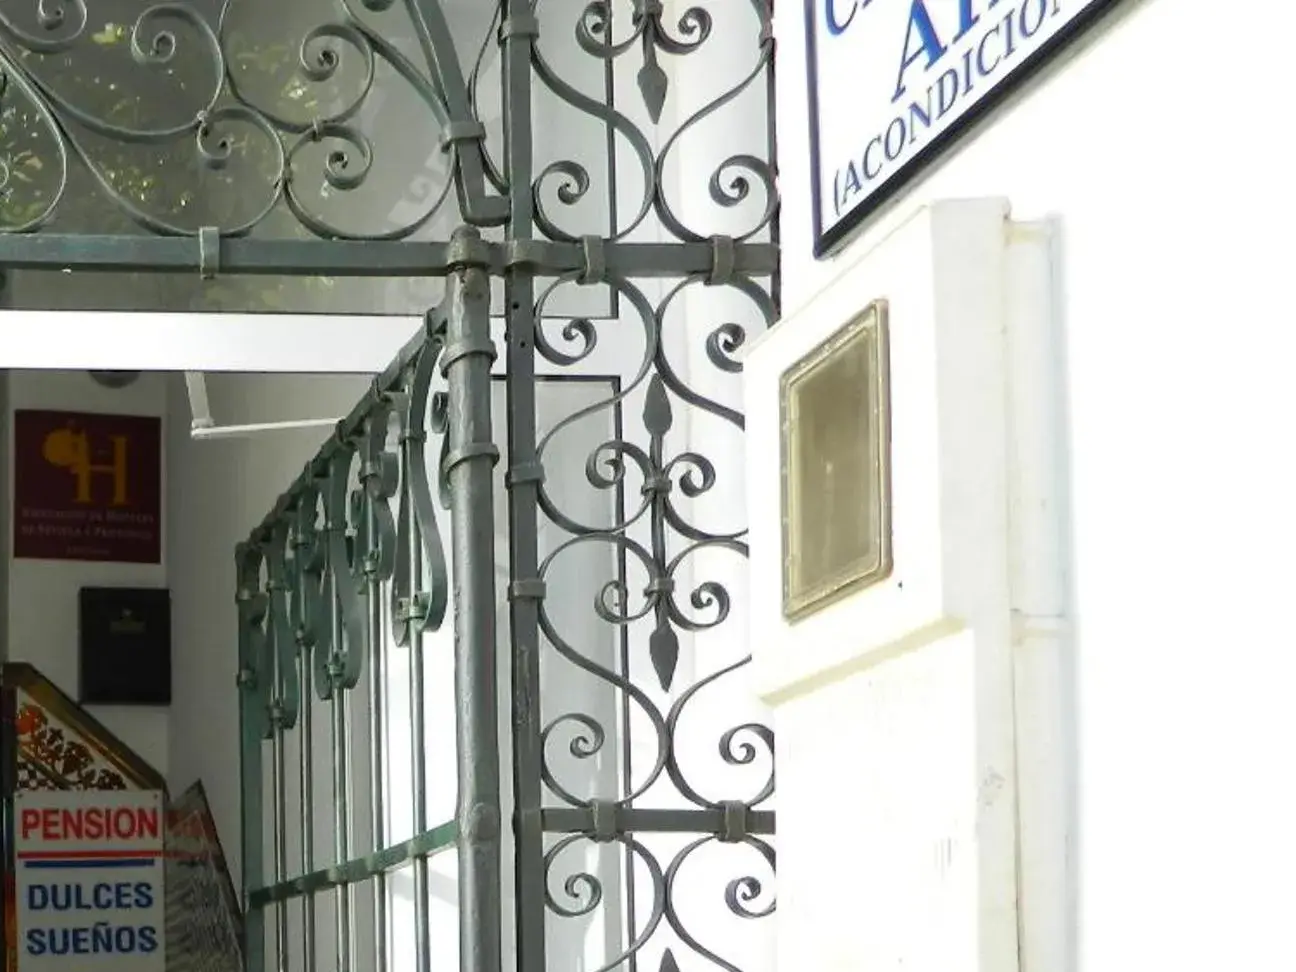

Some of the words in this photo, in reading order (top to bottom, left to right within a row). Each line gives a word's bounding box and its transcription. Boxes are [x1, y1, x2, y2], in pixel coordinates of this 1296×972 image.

[21, 807, 158, 840] PENSION
[28, 881, 153, 911] DULCES
[26, 922, 157, 956] SUEÑOS
